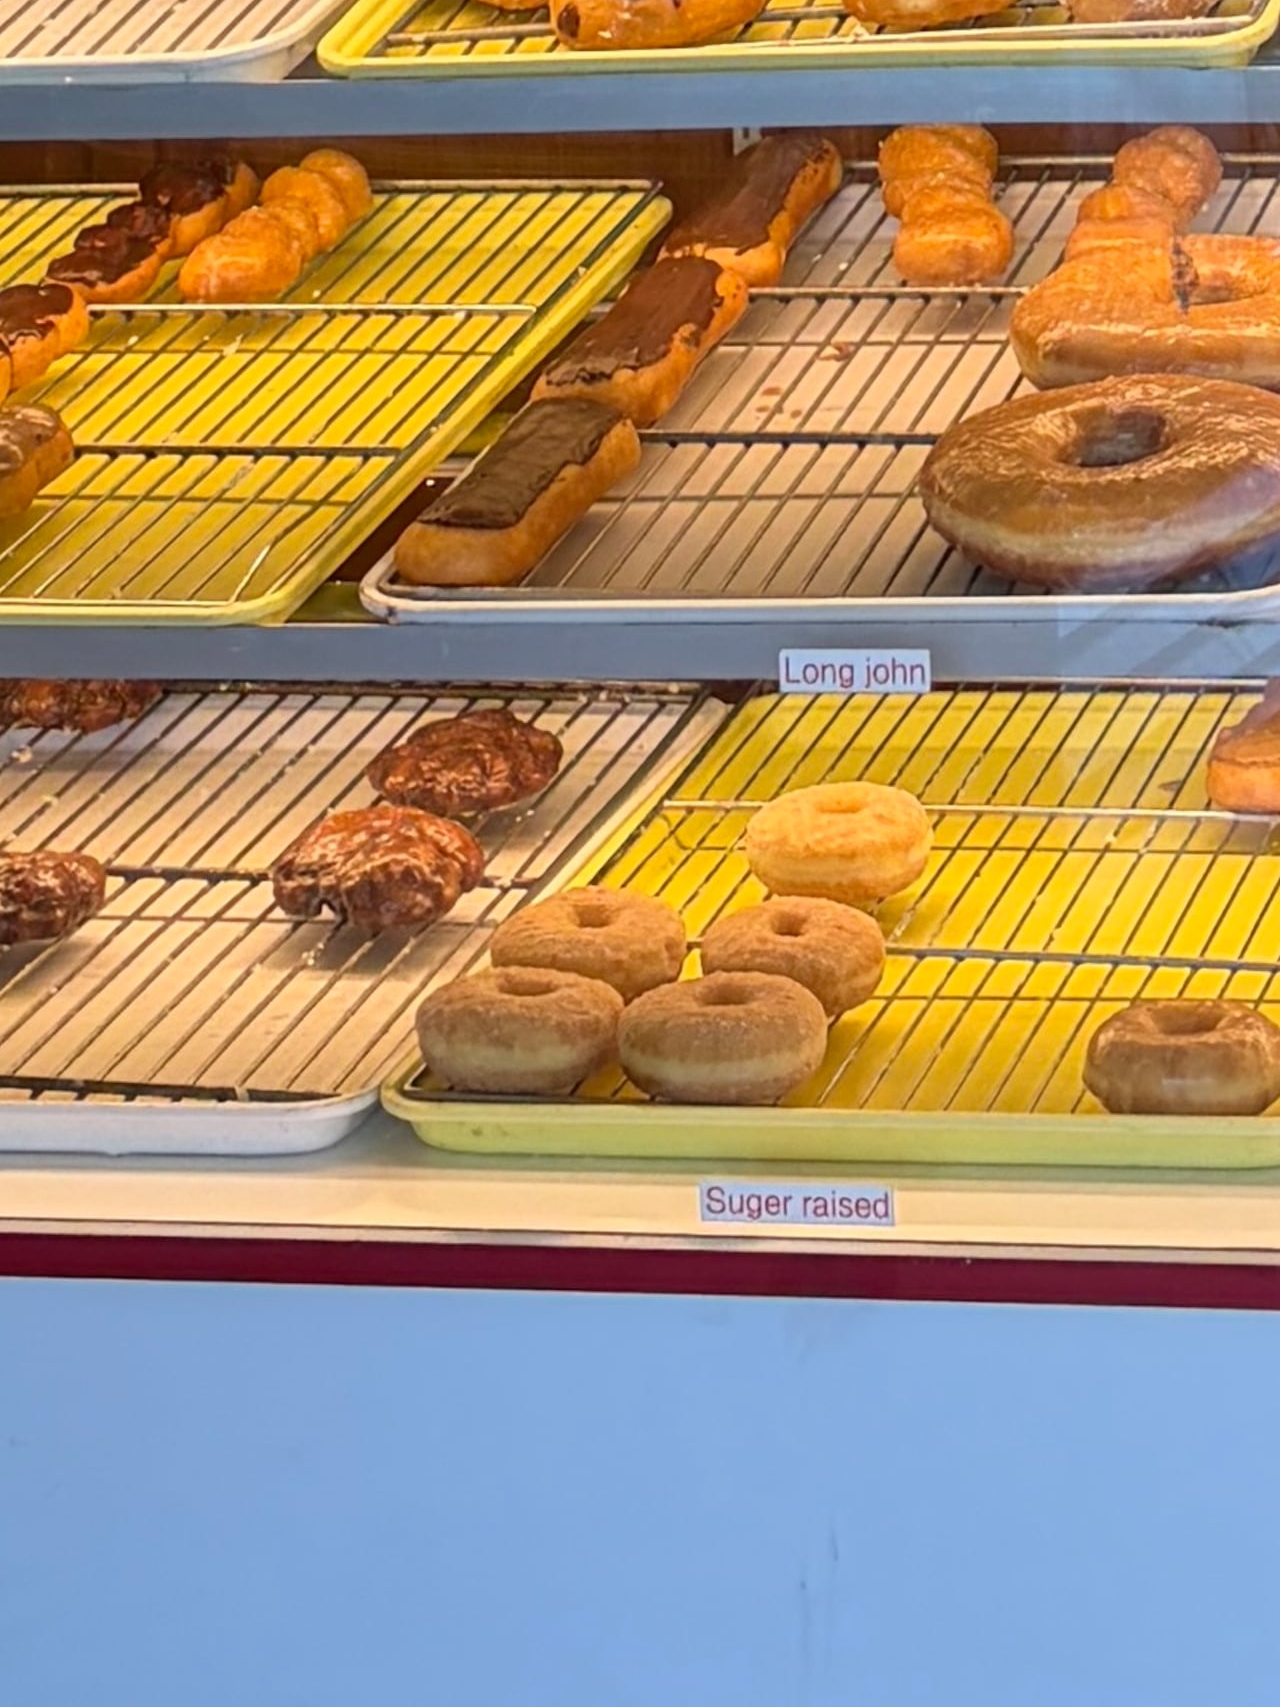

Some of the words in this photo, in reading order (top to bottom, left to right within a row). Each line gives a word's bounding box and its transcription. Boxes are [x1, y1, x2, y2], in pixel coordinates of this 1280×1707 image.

[785, 656, 854, 689] Long
[865, 657, 925, 688] john
[706, 1186, 792, 1220] Suger
[803, 1190, 889, 1219] raised
